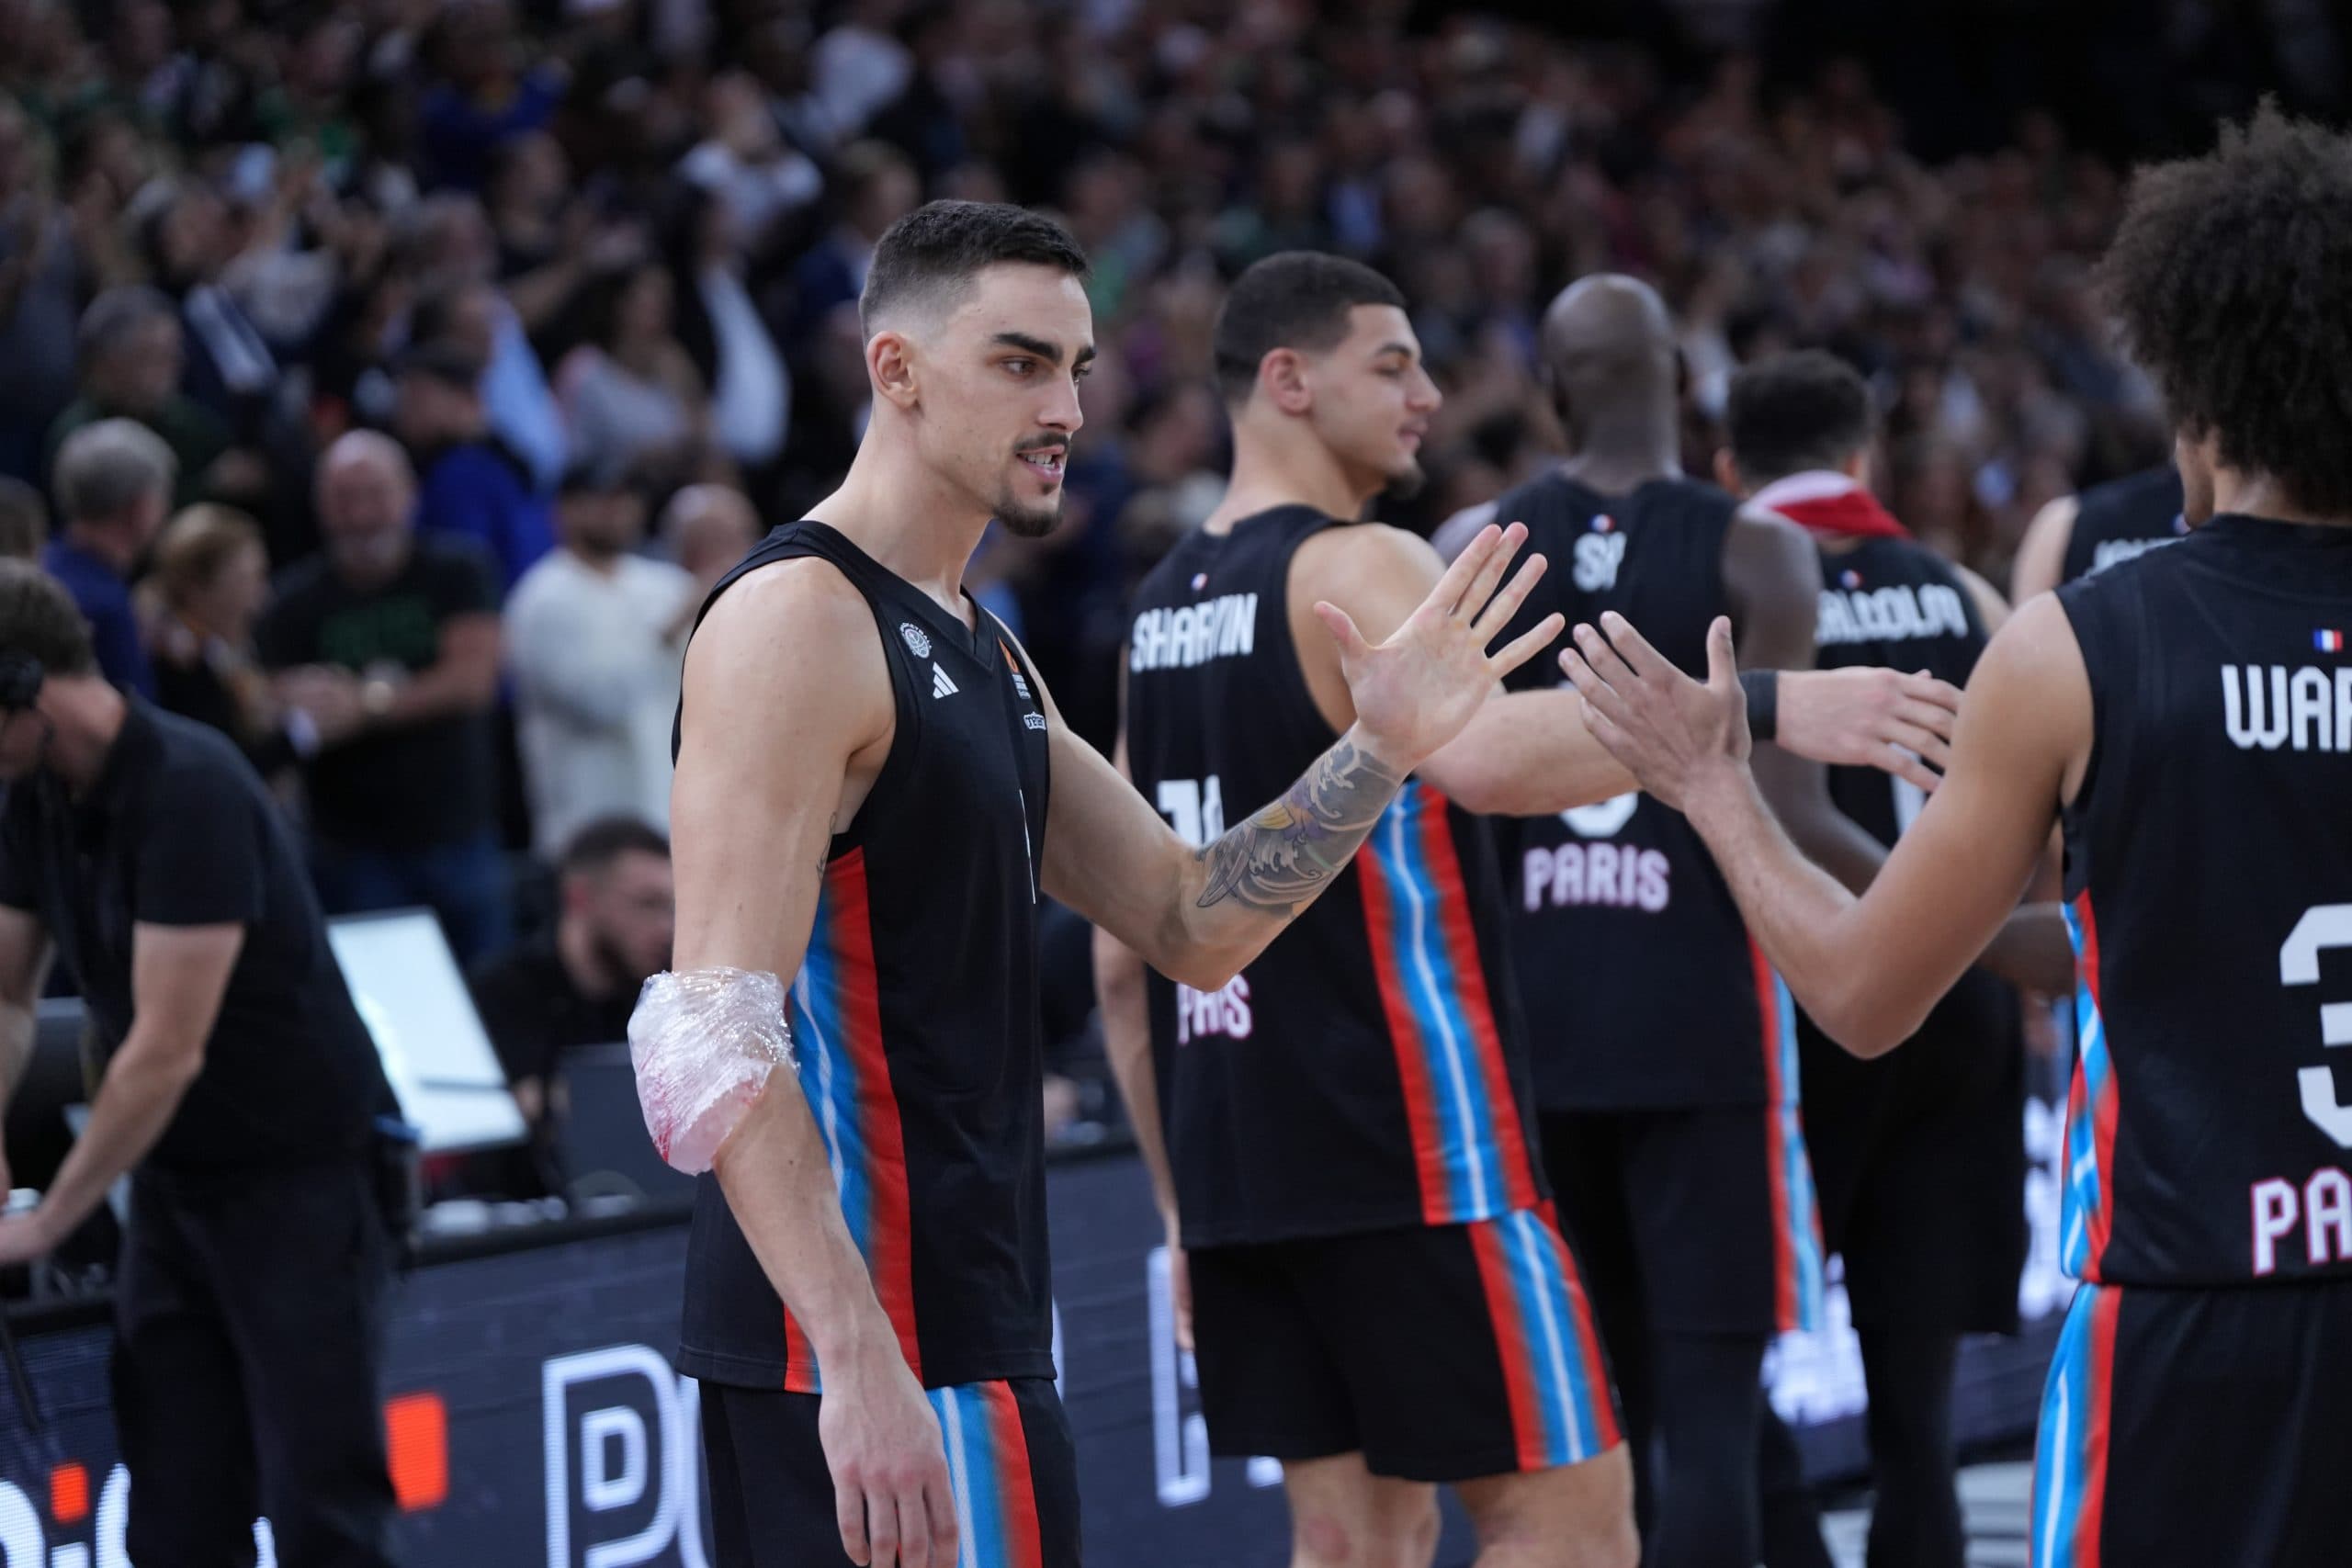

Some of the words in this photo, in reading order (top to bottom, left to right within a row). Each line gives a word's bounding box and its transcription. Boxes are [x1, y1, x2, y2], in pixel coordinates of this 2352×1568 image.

[1573, 532, 1626, 591] SY
[1814, 583, 1969, 644] ALCOLM
[1523, 841, 1670, 912] PARIS
